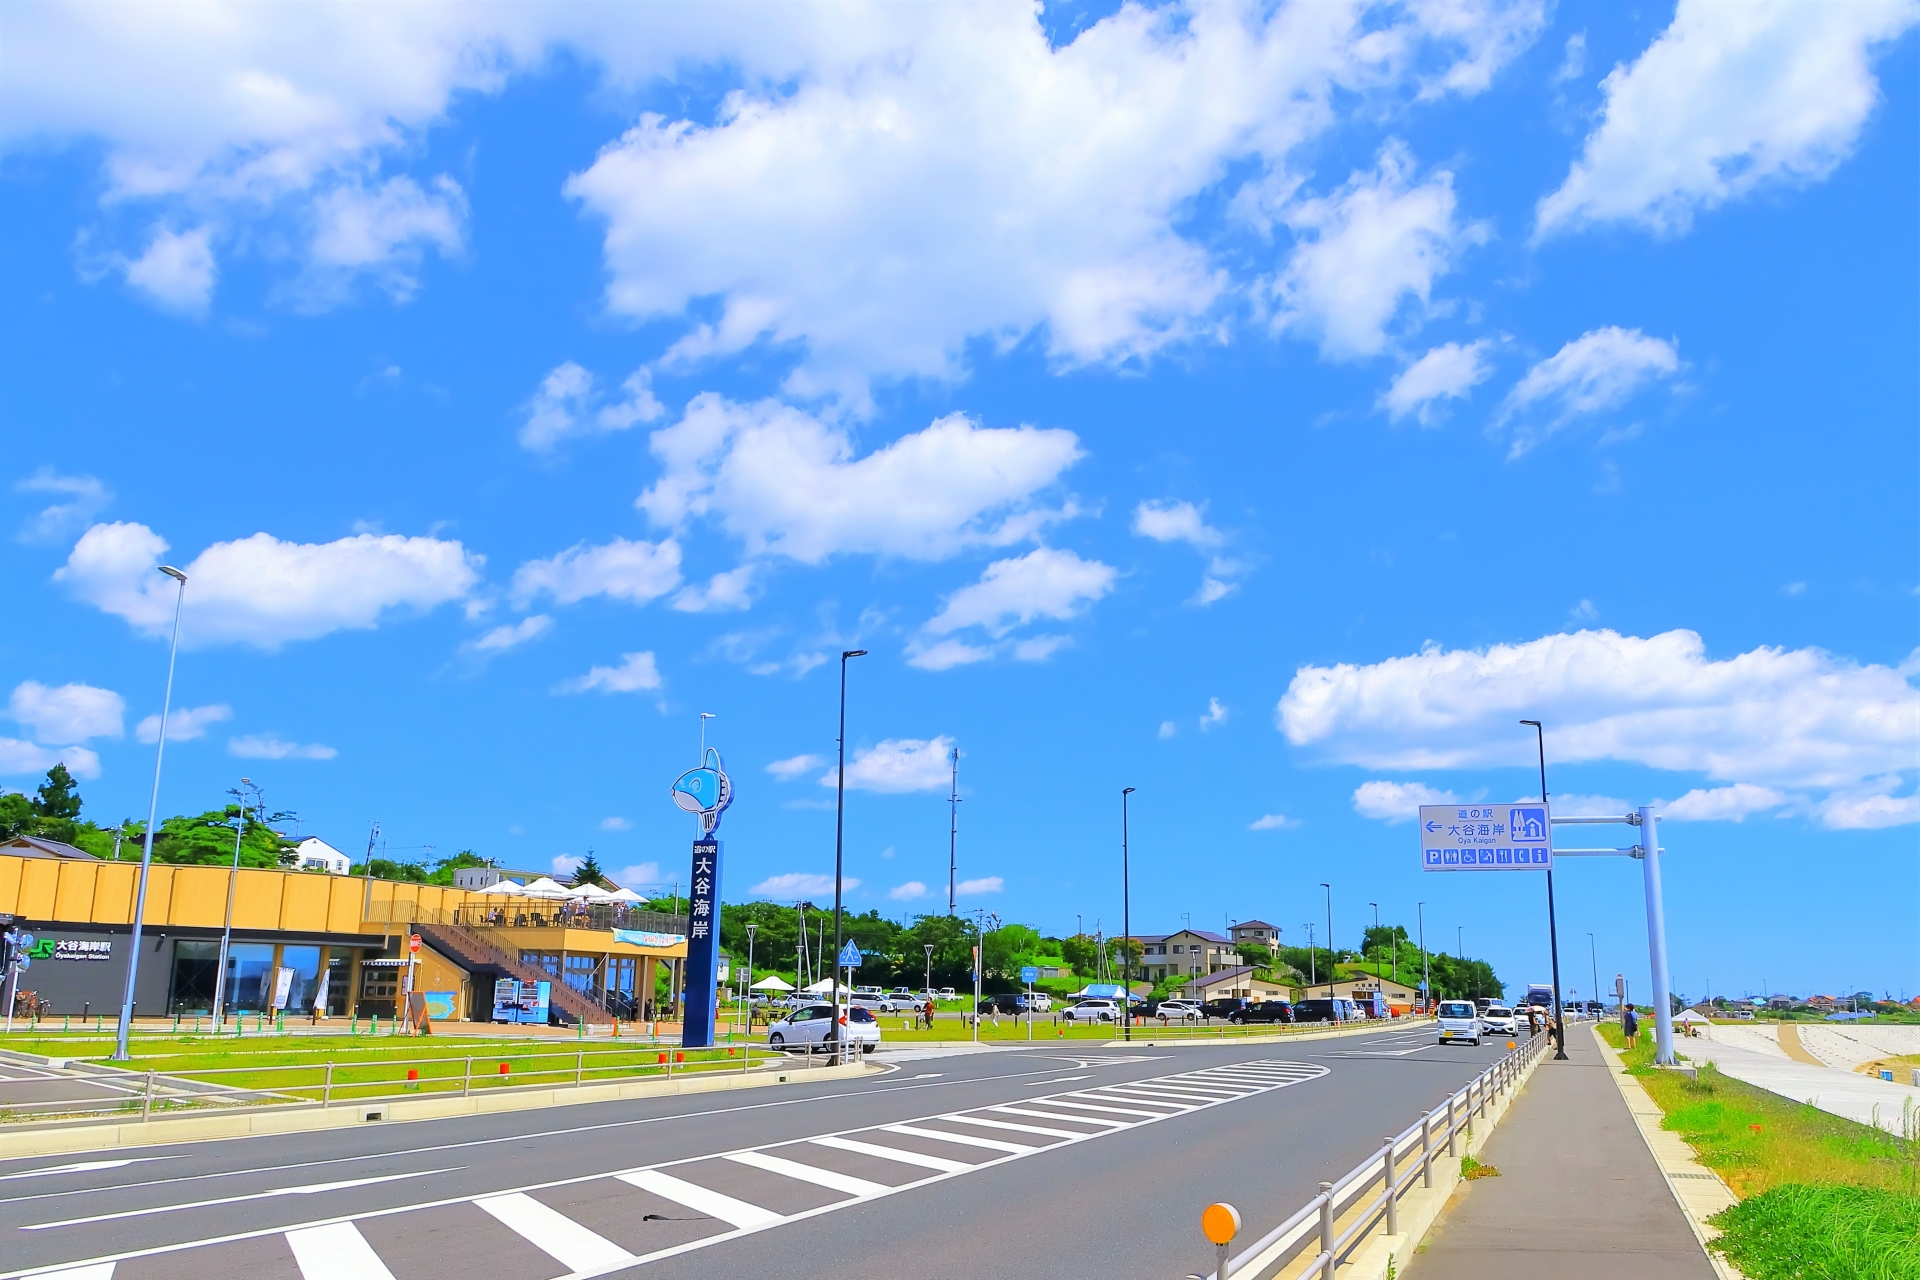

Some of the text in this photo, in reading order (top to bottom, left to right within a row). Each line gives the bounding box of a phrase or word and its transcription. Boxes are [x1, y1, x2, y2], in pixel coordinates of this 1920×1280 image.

[1458, 808, 1493, 819] 道の駅
[1448, 823, 1505, 836] 大谷海岸
[1473, 836, 1496, 845] Kaigan
[694, 845, 716, 854] 道の駅
[691, 857, 713, 939] 大谷海岸
[30, 939, 55, 954] JR
[56, 940, 112, 952] 大谷海岸駅
